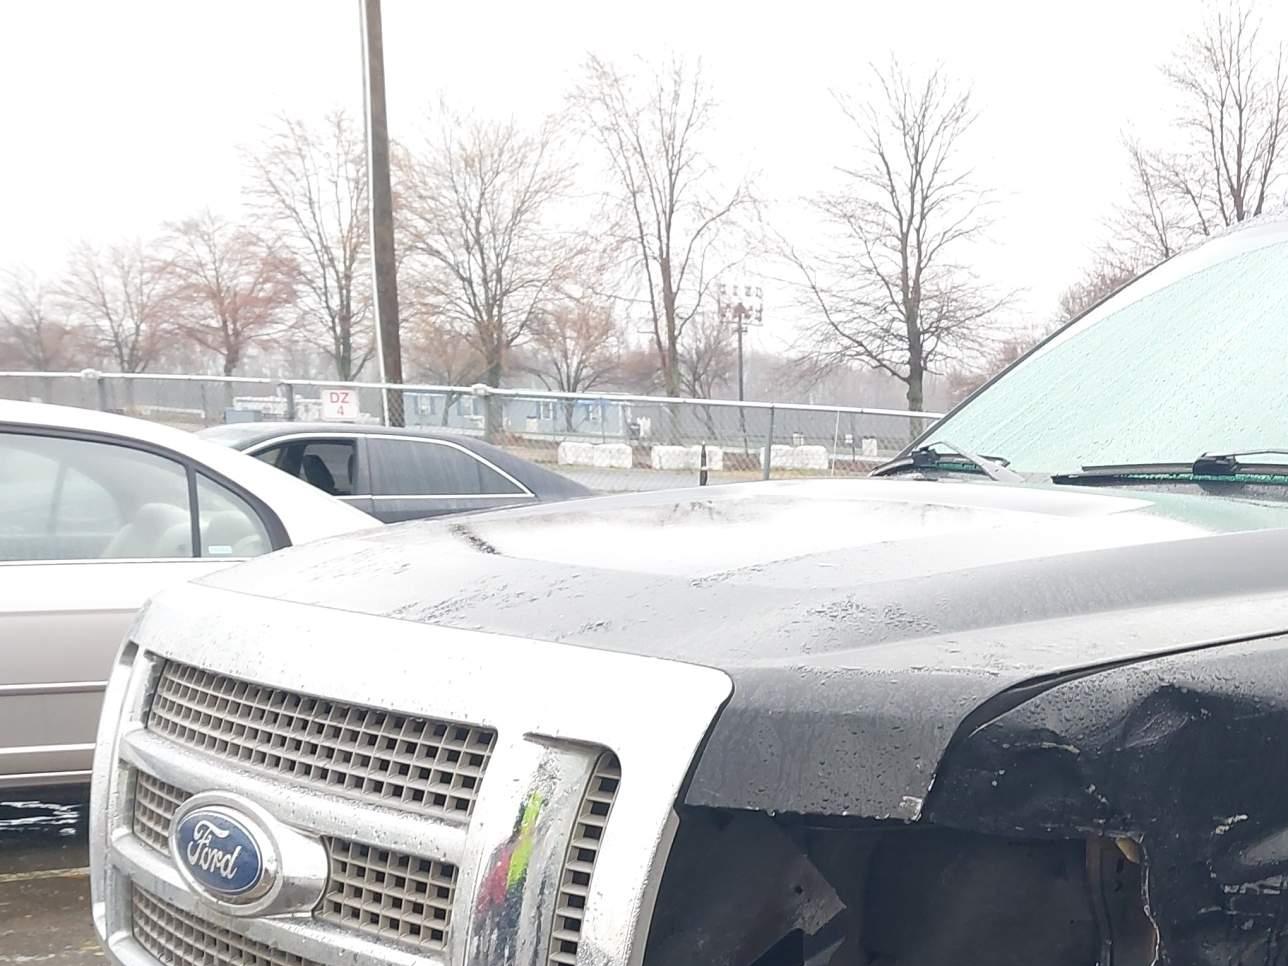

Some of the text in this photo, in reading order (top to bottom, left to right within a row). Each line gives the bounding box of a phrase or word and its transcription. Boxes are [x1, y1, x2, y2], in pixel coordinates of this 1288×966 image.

[329, 391, 350, 404] DZ
[336, 404, 345, 417] 4
[186, 819, 242, 880] Ford
